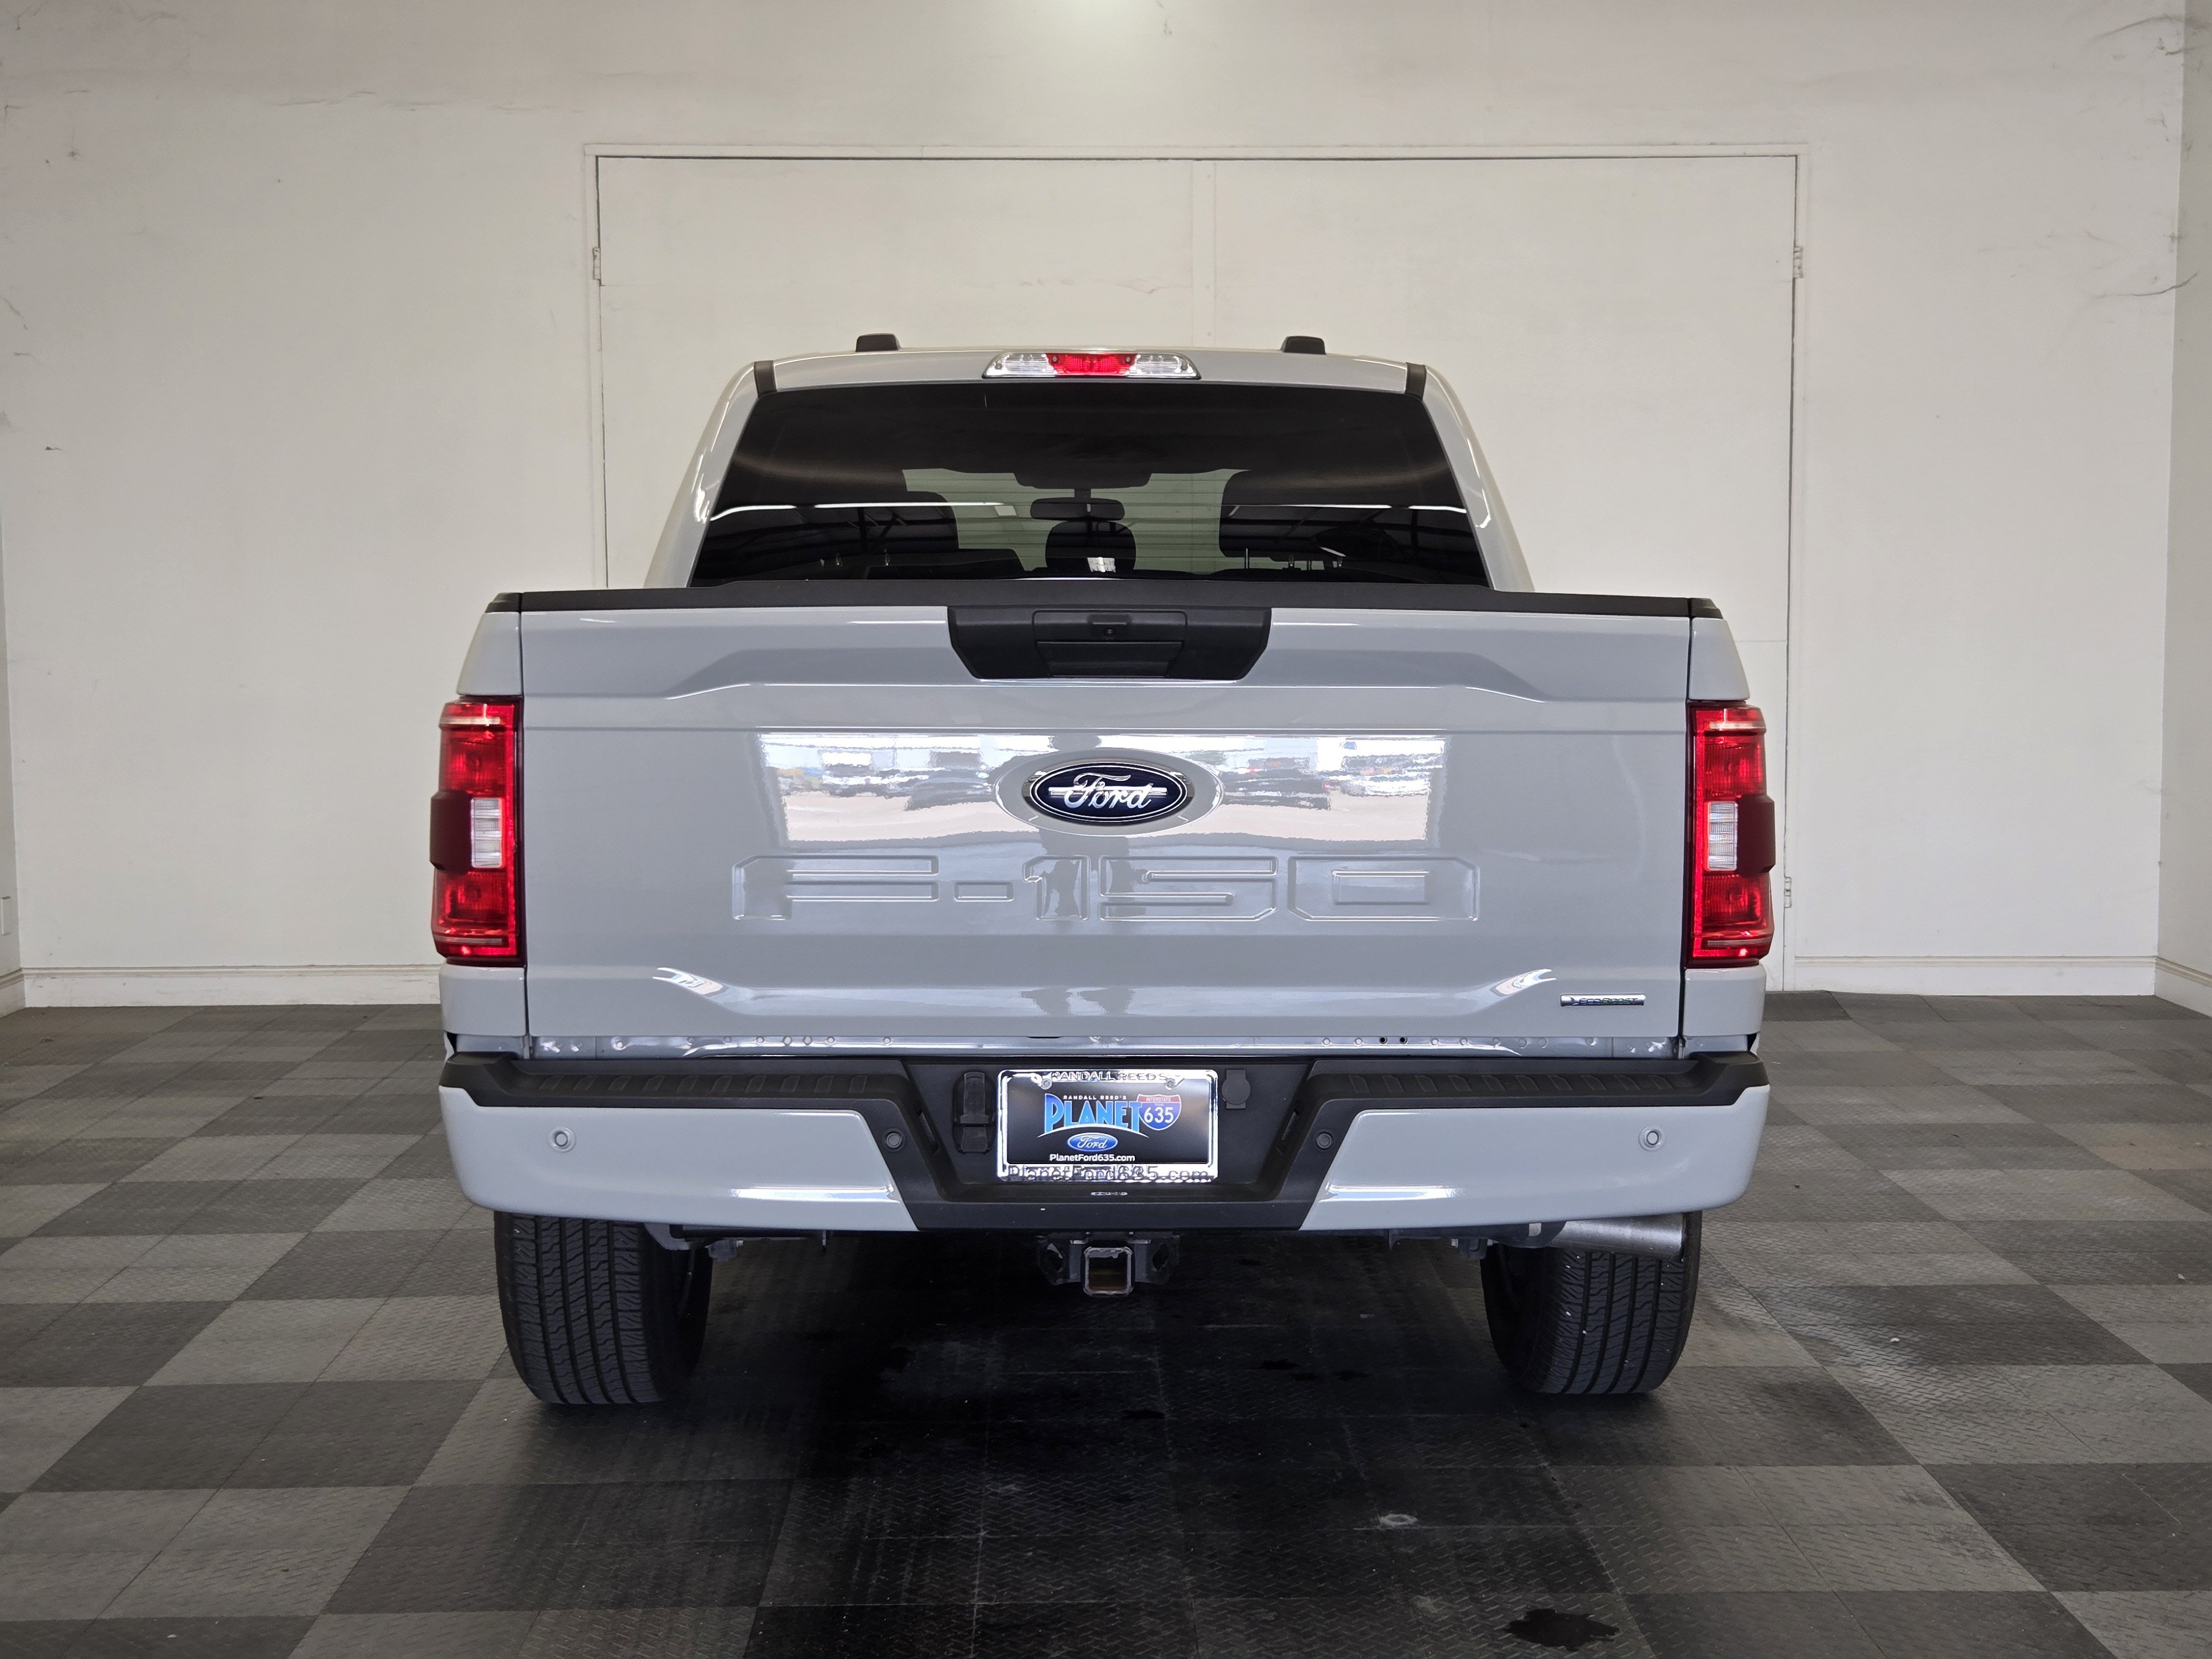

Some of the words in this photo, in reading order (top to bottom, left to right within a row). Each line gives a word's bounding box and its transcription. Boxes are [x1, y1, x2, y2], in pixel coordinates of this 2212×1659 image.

[1064, 773, 1154, 808] Ford
[732, 855, 1480, 921] F-150
[1052, 1071, 1116, 1081] RANDALL
[1045, 1093, 1142, 1133] PLANET
[1144, 1107, 1173, 1123] 635
[1076, 1136, 1108, 1149] Ford
[1050, 1153, 1135, 1162] PlanetFord635.com
[1008, 1165, 1209, 1181] PlanetFord635.com
